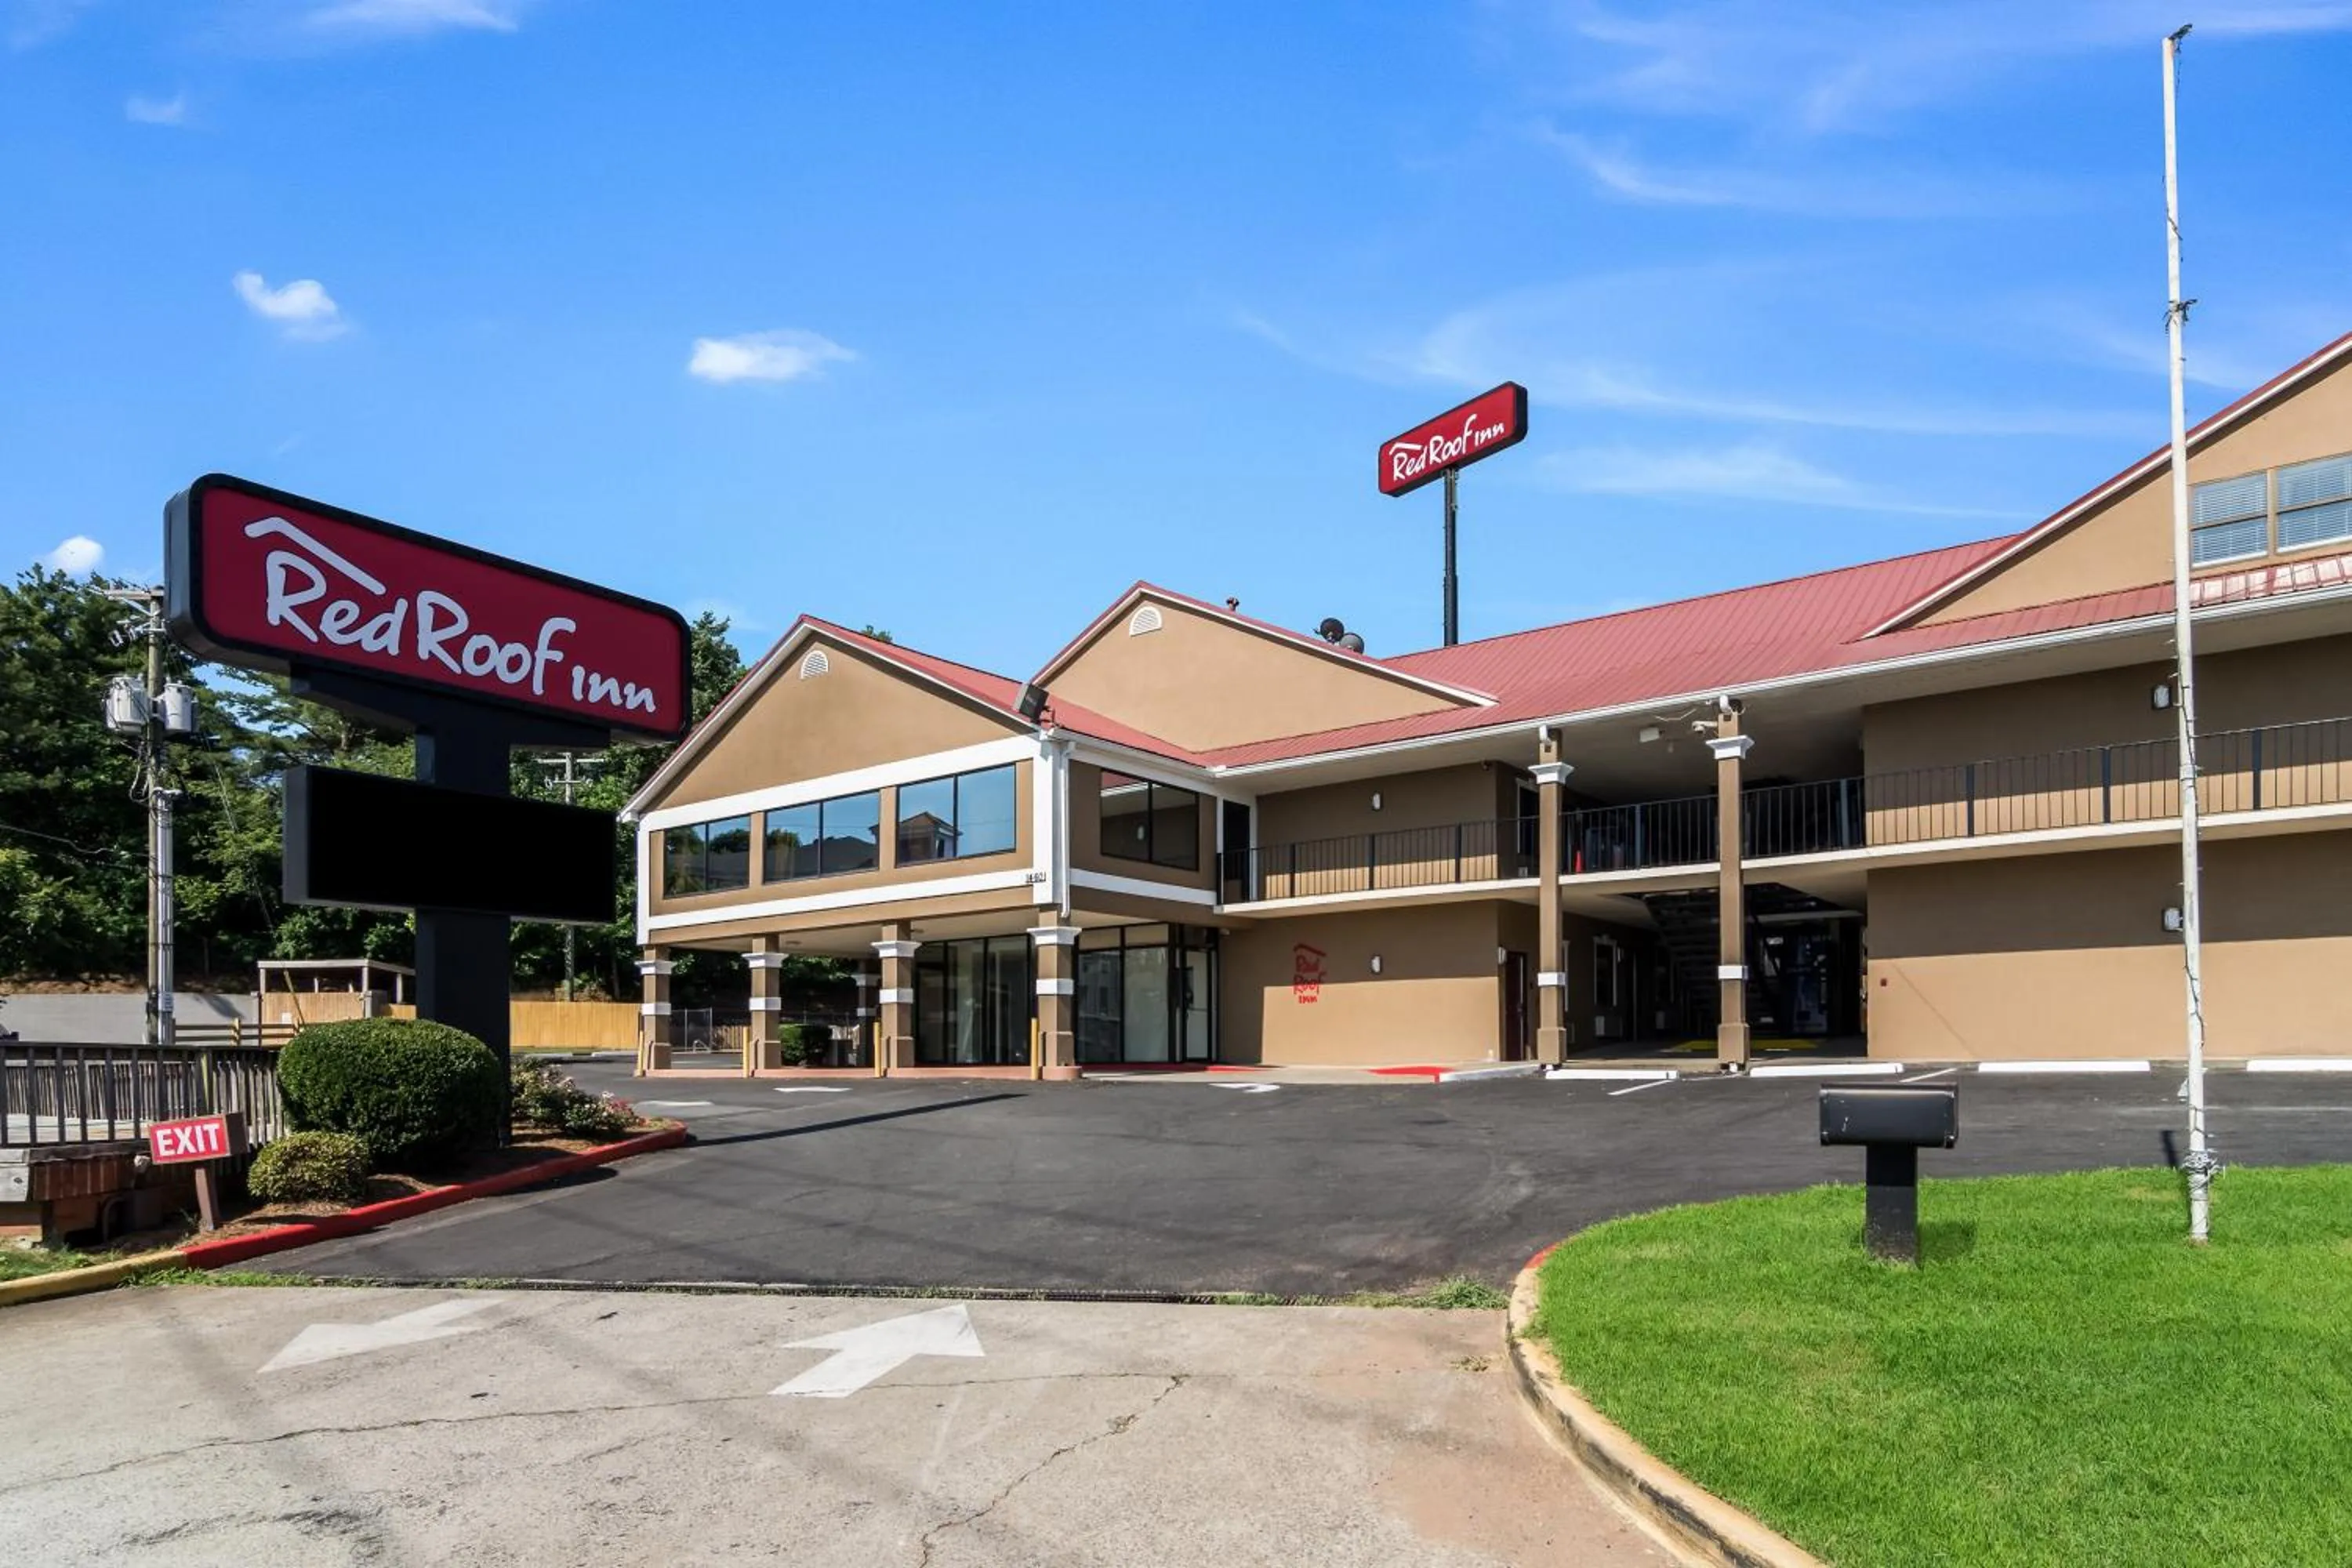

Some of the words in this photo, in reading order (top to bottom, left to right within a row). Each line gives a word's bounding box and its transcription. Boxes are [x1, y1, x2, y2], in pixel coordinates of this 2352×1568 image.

[1393, 445, 1427, 481] Red
[1428, 413, 1478, 465] Roof
[265, 550, 408, 656] Red
[416, 590, 577, 695] Roof
[156, 1123, 220, 1156] EXIT
